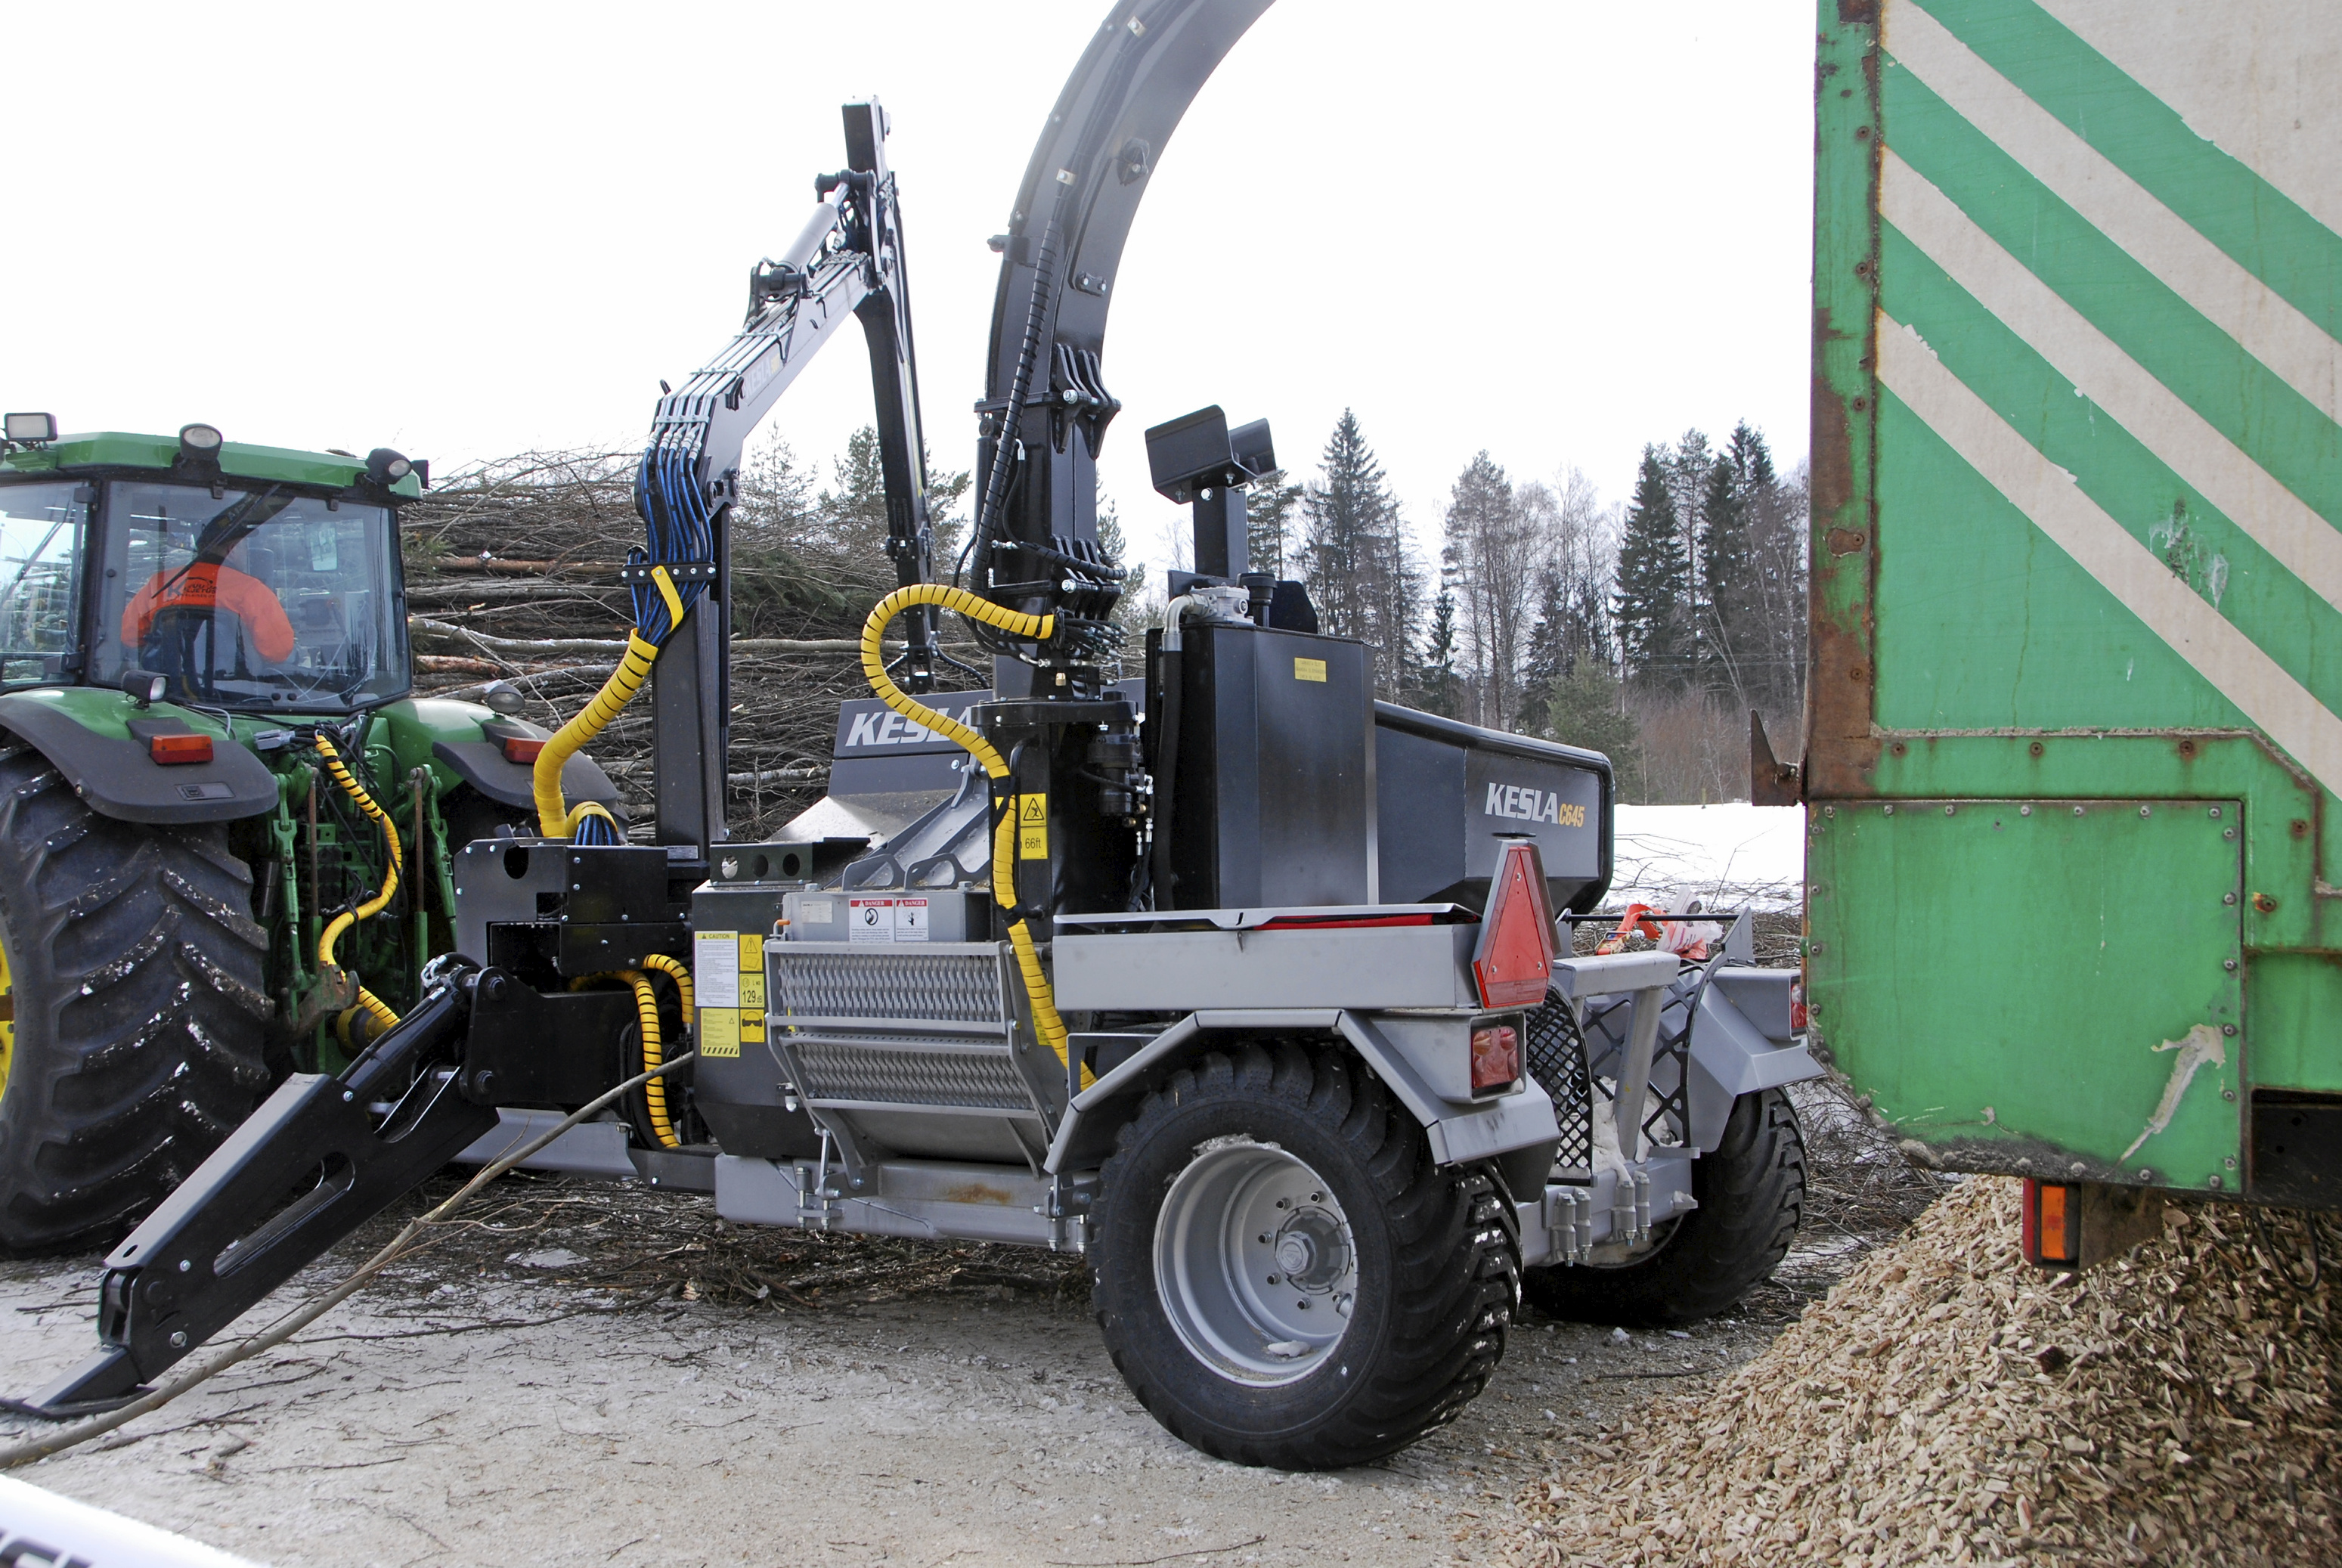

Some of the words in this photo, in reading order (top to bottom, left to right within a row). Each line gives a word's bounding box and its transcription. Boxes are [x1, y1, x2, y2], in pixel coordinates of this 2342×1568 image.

[1485, 782, 1558, 824] KESLA
[1559, 803, 1585, 828] C645
[1024, 838, 1042, 849] 66ft
[742, 990, 756, 1003] 129
